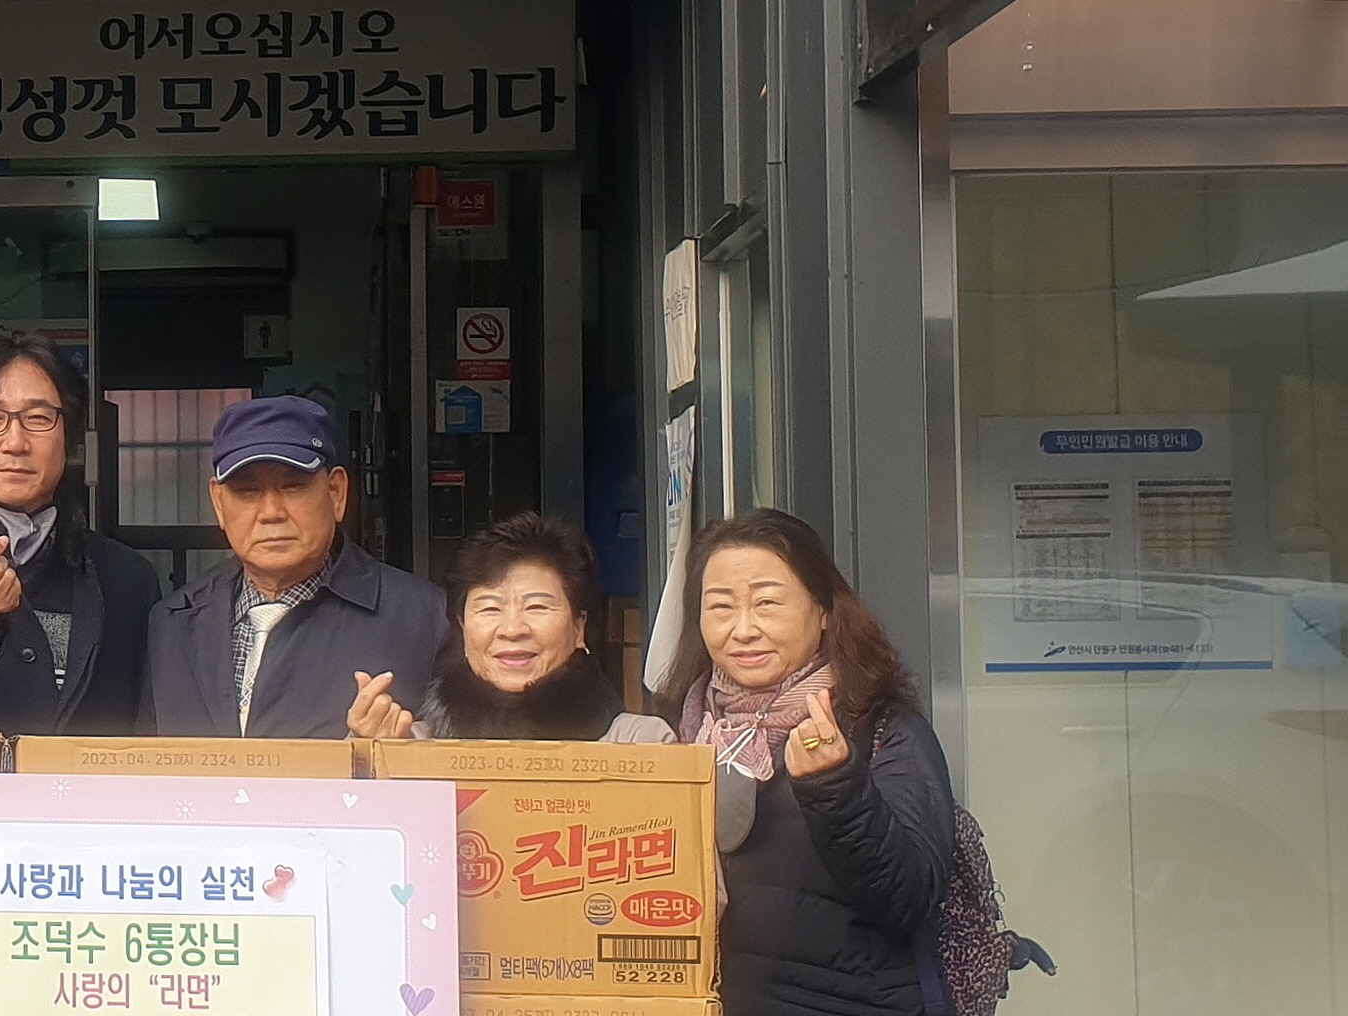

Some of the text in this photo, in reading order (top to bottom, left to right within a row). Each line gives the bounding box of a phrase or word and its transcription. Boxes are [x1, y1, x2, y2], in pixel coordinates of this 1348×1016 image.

[99, 9, 400, 60] 어서오십시오
[155, 67, 565, 141] 모시겠습니다
[1162, 433, 1188, 449] 안내
[200, 753, 237, 767] 2324
[571, 759, 609, 773] 2320
[513, 798, 544, 813] 진하고
[545, 798, 577, 814] 얼큰한
[588, 828, 607, 841] Jin
[460, 862, 492, 881] 뚜기
[512, 823, 676, 901] 진라면
[0, 862, 257, 903] 사랑과 나눔의 실천
[628, 896, 696, 922] 매운맛
[10, 920, 242, 967] 조덕수 6통장님
[615, 970, 685, 983] 52 228
[52, 972, 132, 1010] 사랑의
